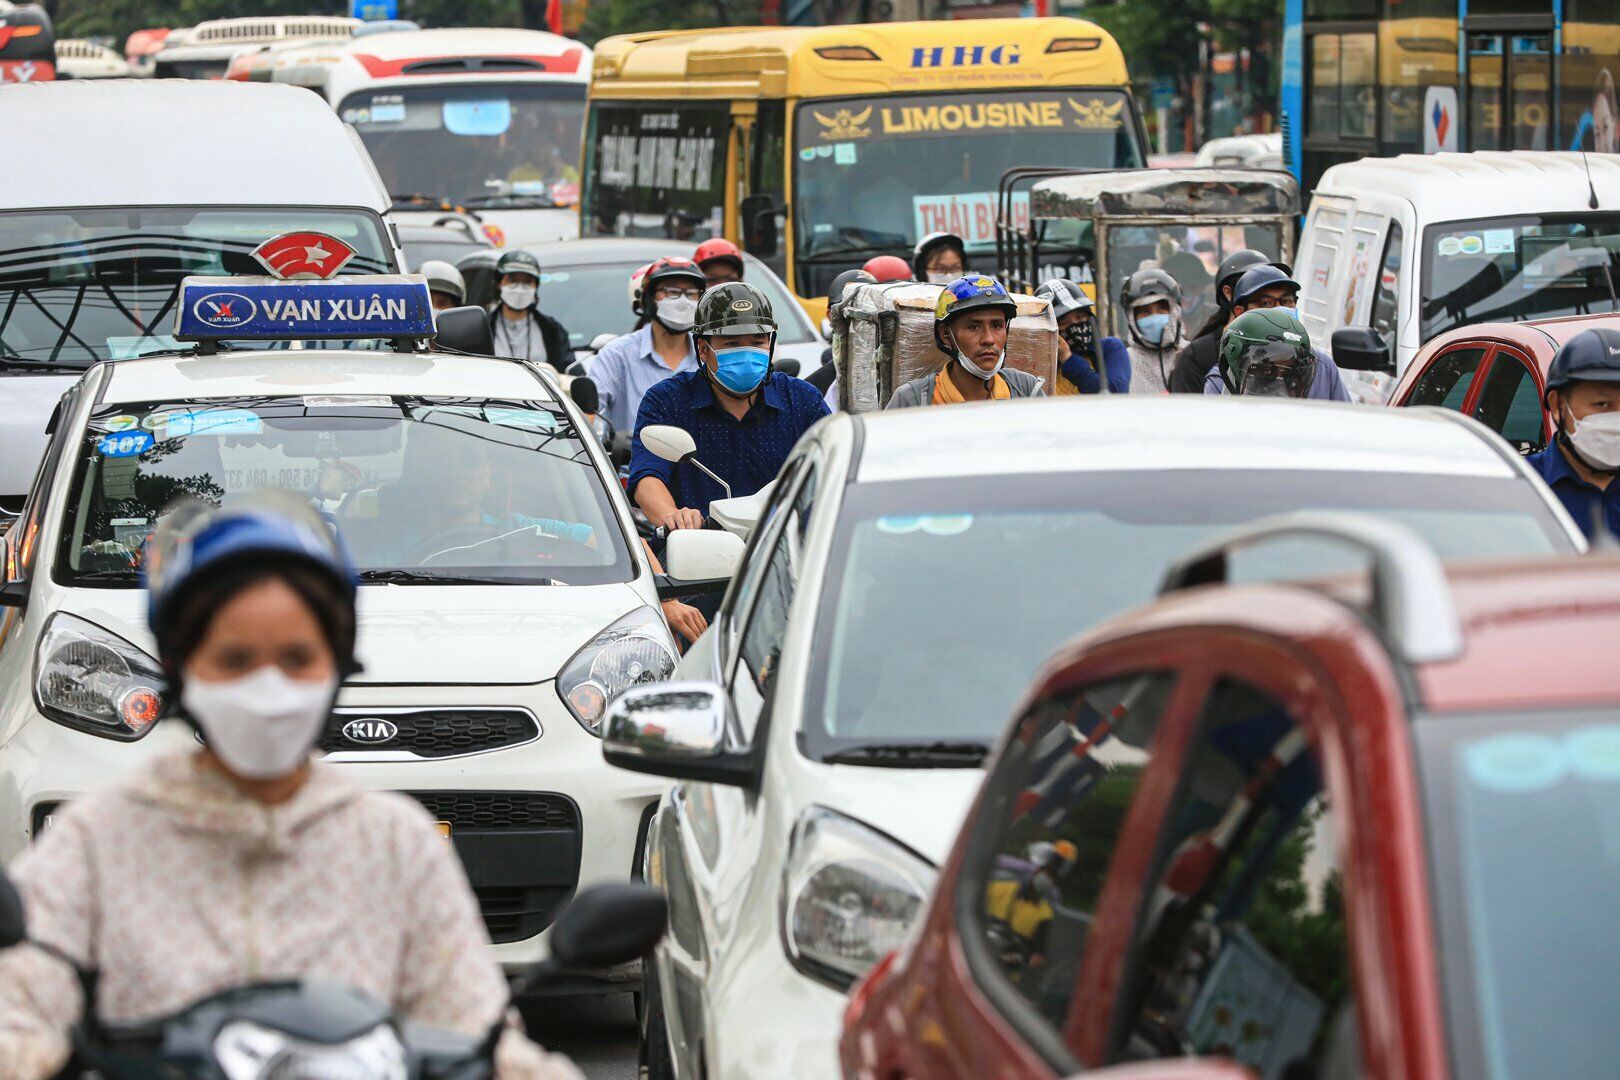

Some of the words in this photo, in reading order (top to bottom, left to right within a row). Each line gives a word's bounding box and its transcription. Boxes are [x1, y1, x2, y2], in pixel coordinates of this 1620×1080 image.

[910, 45, 1022, 68] HHG
[882, 102, 1063, 132] LIMOUSINE
[919, 196, 970, 240] THÁI
[261, 299, 321, 327] VẠN
[328, 293, 406, 321] XUÂN
[351, 722, 390, 738] KIA
